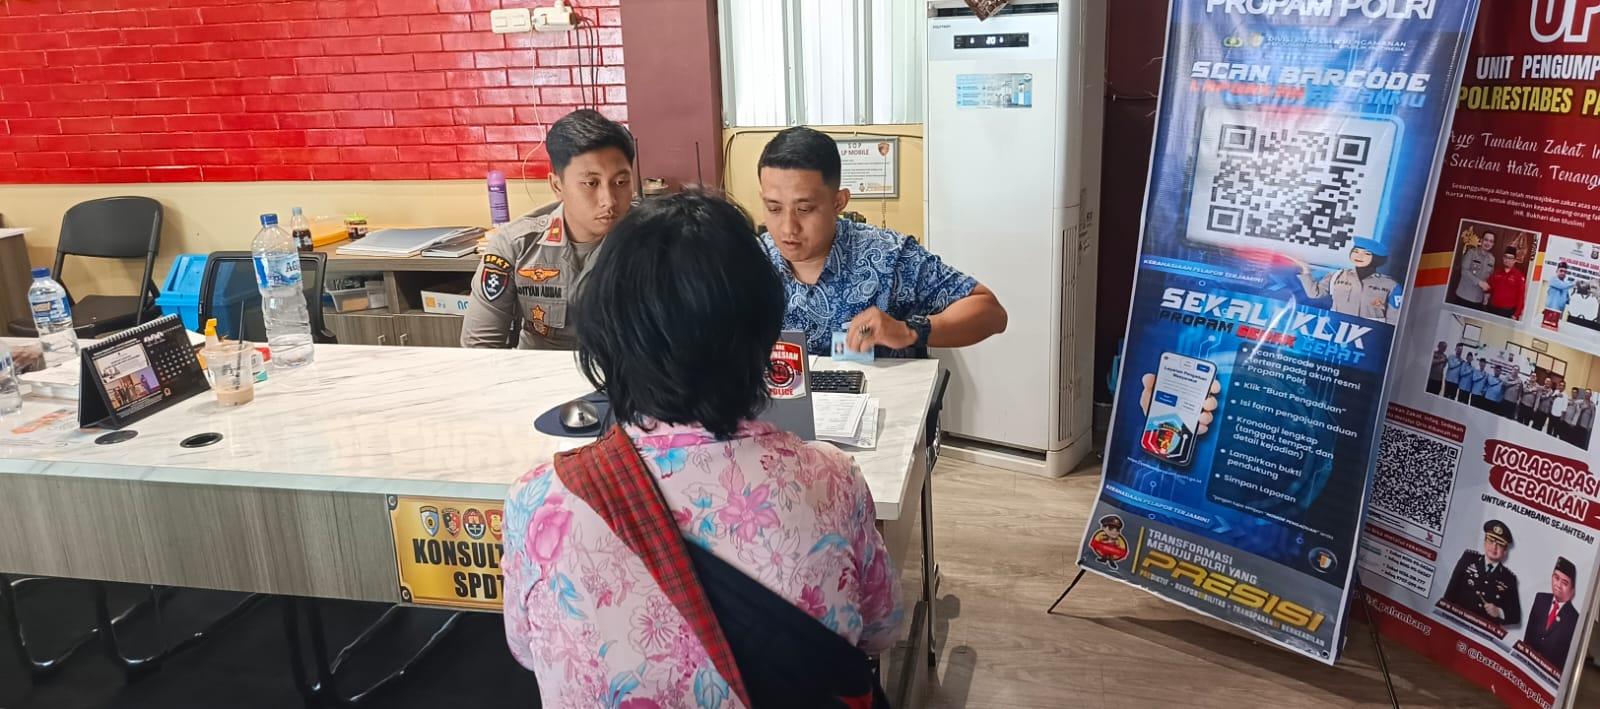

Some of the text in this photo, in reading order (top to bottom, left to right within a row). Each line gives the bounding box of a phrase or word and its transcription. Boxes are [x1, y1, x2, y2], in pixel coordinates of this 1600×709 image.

[1206, 0, 1437, 20] PROPAM POLRI
[1529, 0, 1600, 43] UP
[1191, 61, 1271, 82] SCAN
[1279, 66, 1431, 92] BARCODE
[1476, 54, 1600, 81] UNIT PENGUMP
[1457, 85, 1600, 116] POLRESTABES PA
[1481, 132, 1539, 152] Tunaikan
[1450, 153, 1502, 173] Sucikan
[1549, 164, 1600, 191] Tenang
[485, 254, 510, 269] SPKT
[1160, 310, 1234, 333] PROPAM
[1291, 311, 1373, 350] KLIK
[1247, 365, 1285, 379] Propam
[1275, 352, 1315, 368] Barcode
[1316, 364, 1340, 376] yang
[1282, 364, 1308, 376] pada
[1308, 370, 1333, 383] akun
[1333, 378, 1361, 390] resmi
[1243, 382, 1261, 391] Klik
[1236, 416, 1319, 445] Kronologi lengkap
[1240, 399, 1358, 438] Isi form pengajuan aduan
[1232, 433, 1304, 460] detail kejadian)
[1315, 447, 1334, 460] dan
[1227, 458, 1279, 480] pendukung
[1228, 449, 1302, 477] Lampirkan bukti
[1493, 445, 1600, 497] KOLABORASI
[1223, 474, 1297, 503] Simpan Laporan
[1501, 471, 1589, 521] KEBAIKAN
[1481, 494, 1594, 545] UNTUK PALEMBANG SEJAHTERA!!
[412, 538, 504, 568] KONSULT
[1146, 538, 1258, 585] MENUJU POLRI YANG
[1148, 528, 1234, 566] TRANSFORMASI
[1141, 550, 1326, 633] PRESISI
